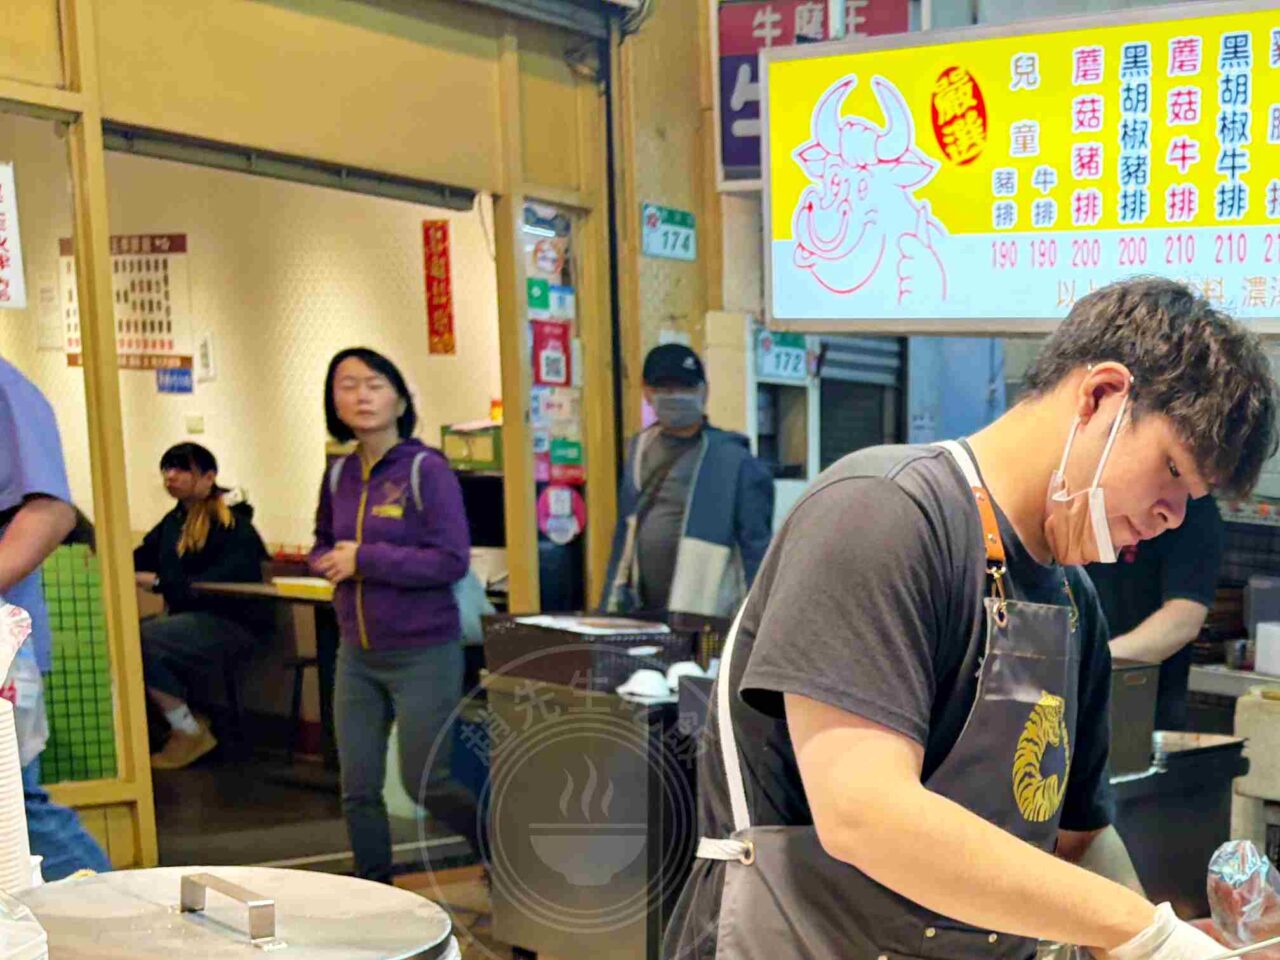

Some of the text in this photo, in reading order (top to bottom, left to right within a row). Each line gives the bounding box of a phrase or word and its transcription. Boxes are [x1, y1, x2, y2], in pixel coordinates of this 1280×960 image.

[1012, 55, 1038, 155] 兒童
[1073, 48, 1102, 224] 蘑菇豬排
[1120, 44, 1149, 221] 黑胡椒豬排
[1168, 38, 1199, 220] 蘑菇牛排
[1217, 34, 1249, 218] 黑胡椒牛排
[662, 230, 691, 252] 174
[992, 241, 1017, 268] 190
[1030, 240, 1057, 267] 190
[1072, 239, 1100, 267] 200
[1118, 237, 1147, 265] 200
[1165, 234, 1195, 264] 210
[1215, 233, 1247, 263] 210
